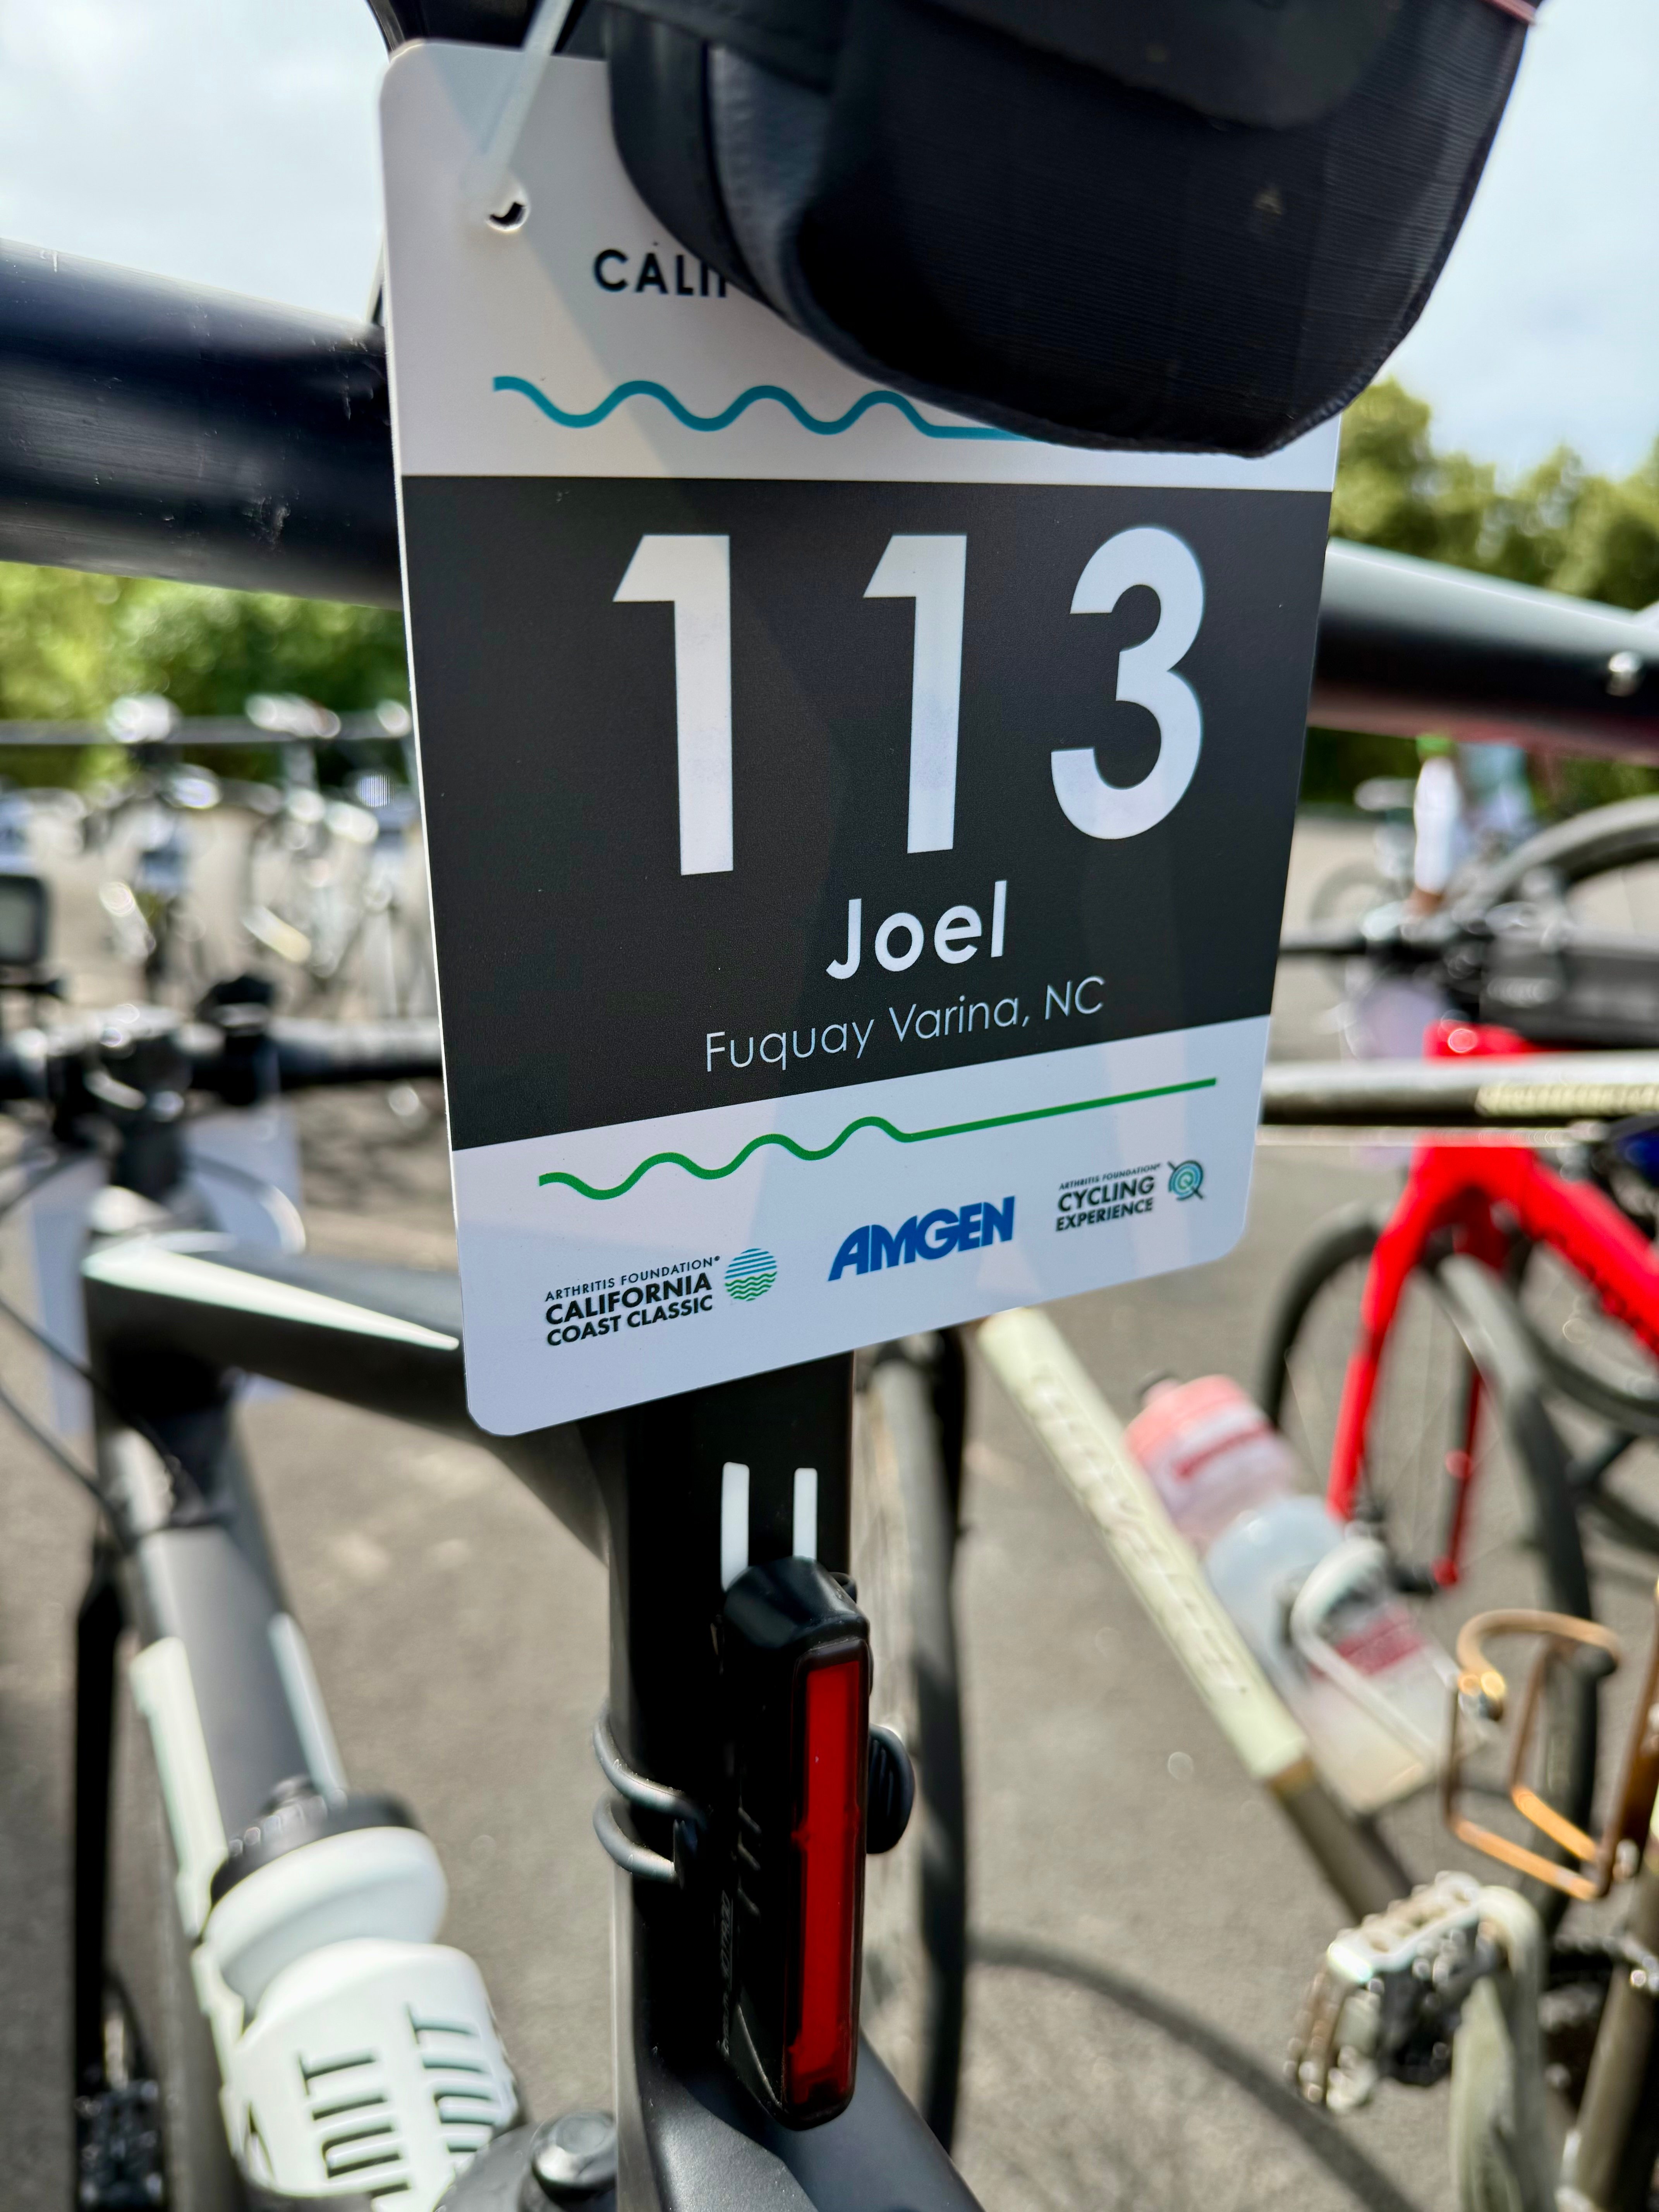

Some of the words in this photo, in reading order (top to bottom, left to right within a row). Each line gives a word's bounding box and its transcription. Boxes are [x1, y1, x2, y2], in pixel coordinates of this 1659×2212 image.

[613, 526, 1204, 876] 113
[826, 880, 1007, 979] Joel
[706, 1019, 874, 1072] Fuquay
[889, 995, 1029, 1042] Varina,
[1045, 976, 1104, 1020] NC
[1058, 1176, 1154, 1212] CYCLING
[1059, 1175, 1100, 1190] ARTHRITIS
[828, 1195, 1015, 1281] AMGEN
[1056, 1198, 1153, 1231] EXPERIENCE
[545, 1278, 615, 1302] ARTHRITIS
[546, 1272, 712, 1325] CALIFORNIA
[547, 1315, 622, 1346] COAST
[627, 1295, 713, 1328] CLASSIC
